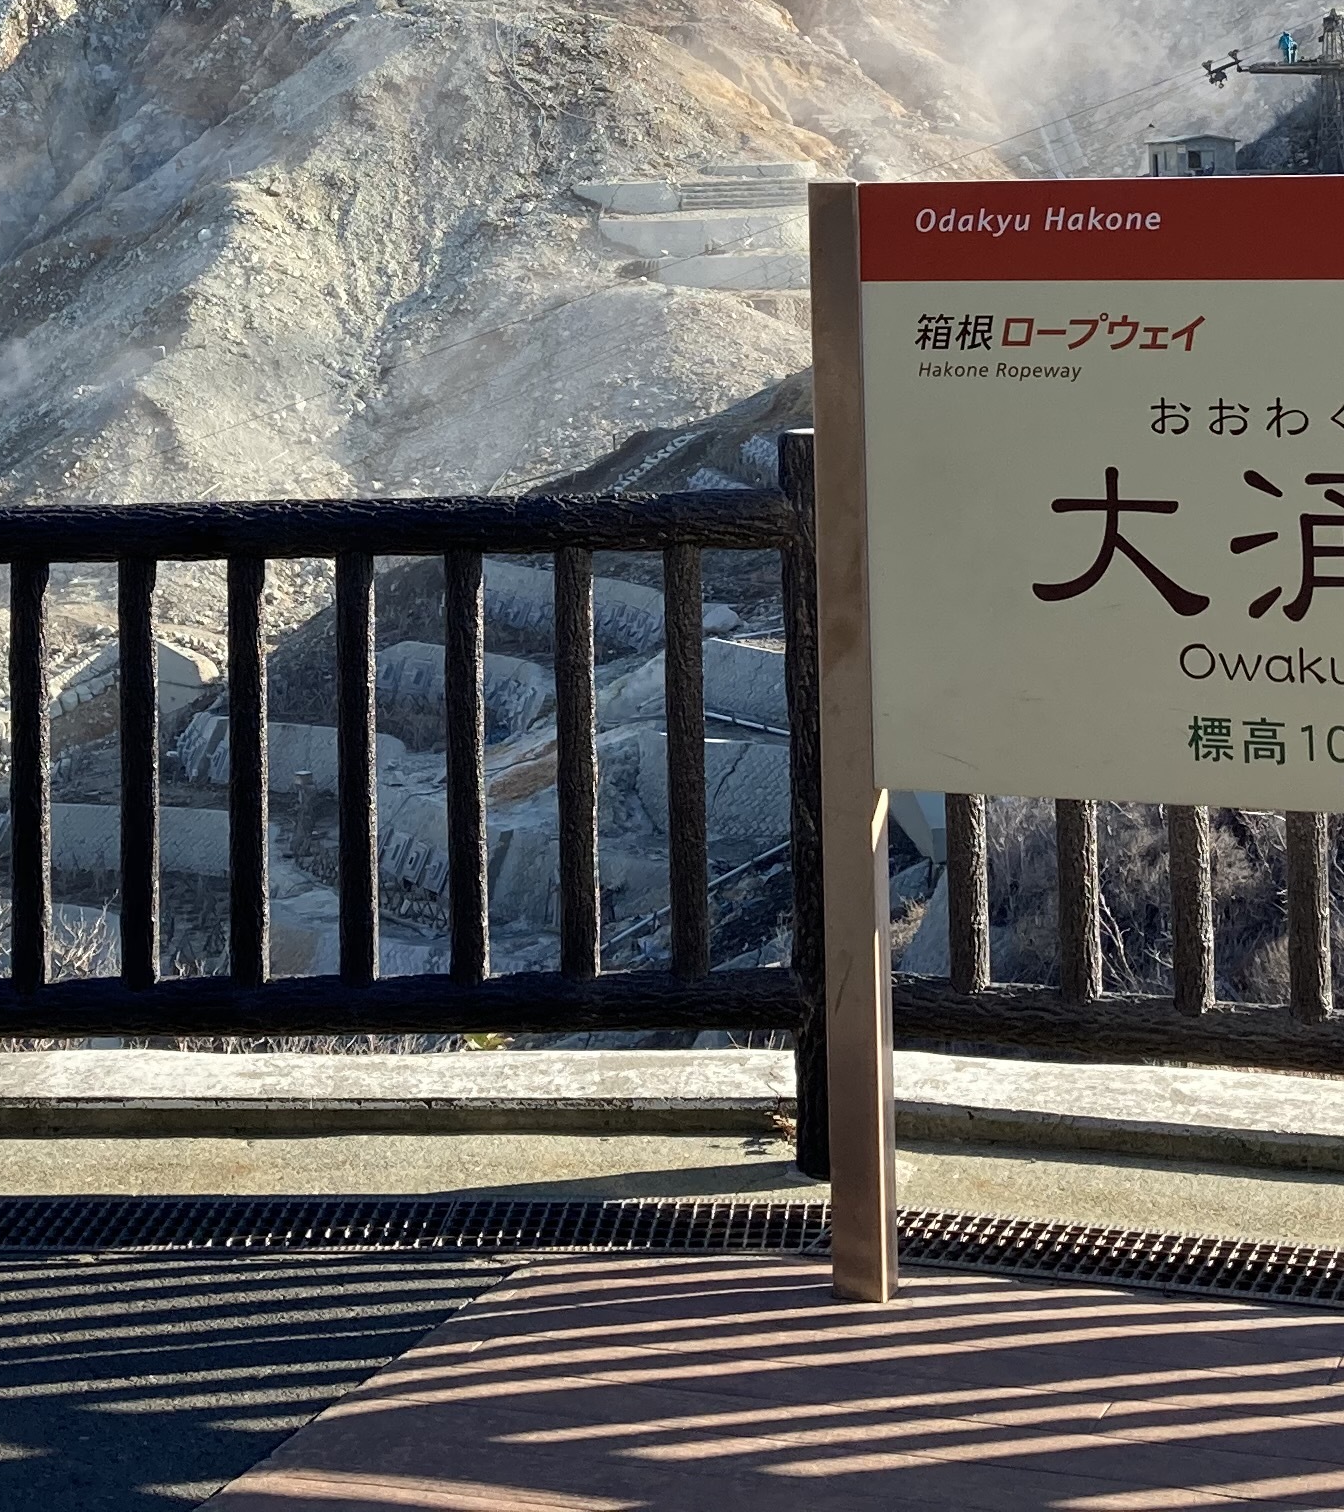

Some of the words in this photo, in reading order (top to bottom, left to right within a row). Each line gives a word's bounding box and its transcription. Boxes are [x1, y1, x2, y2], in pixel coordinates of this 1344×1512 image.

[914, 206, 1032, 238] Odakyu
[1043, 205, 1162, 232] Hakone
[913, 311, 1207, 353] 箱根ロープウェイ
[917, 360, 990, 379] Hakone
[995, 361, 1082, 384] Ropeway
